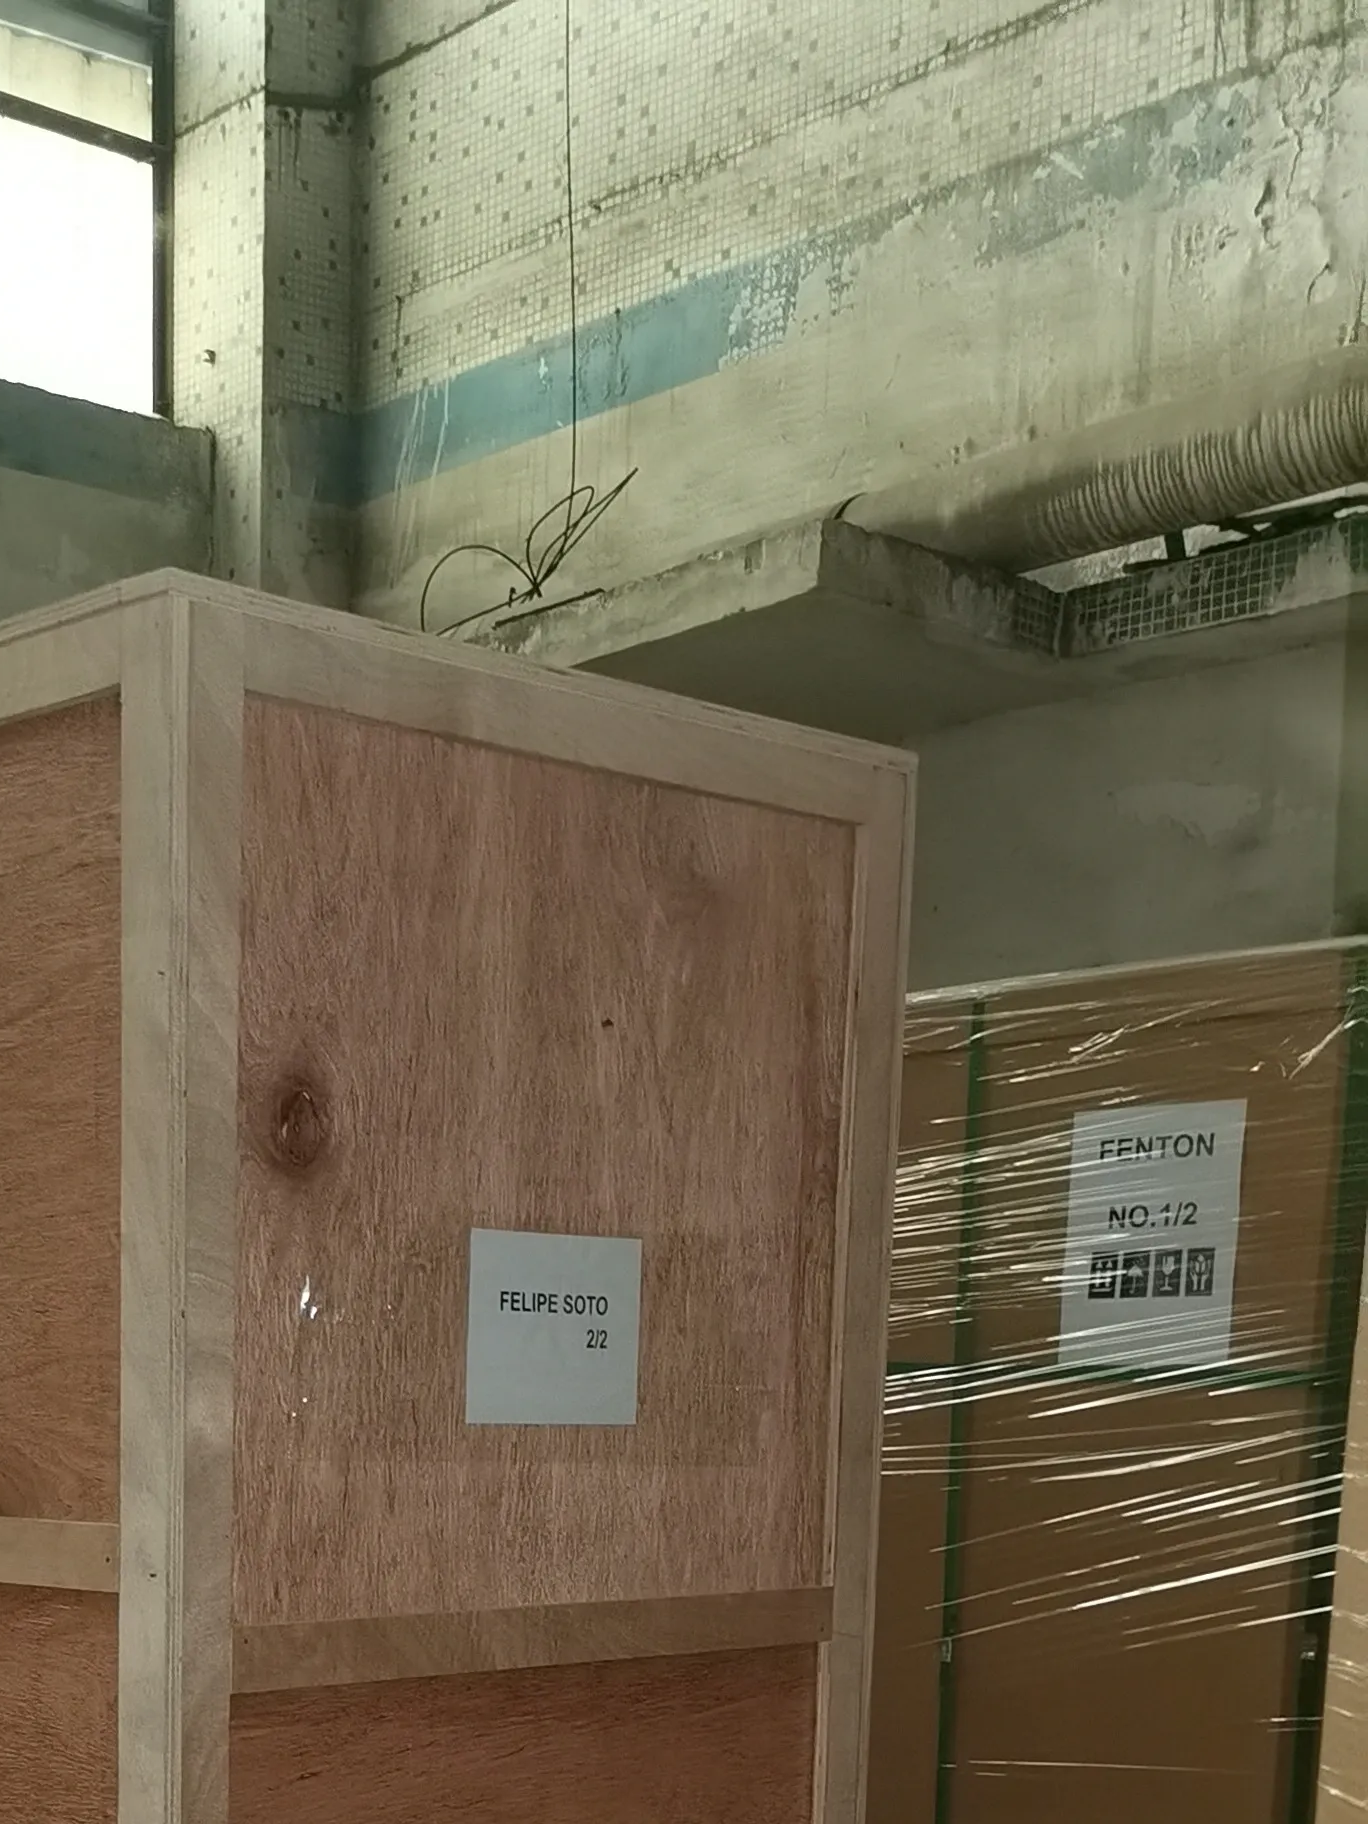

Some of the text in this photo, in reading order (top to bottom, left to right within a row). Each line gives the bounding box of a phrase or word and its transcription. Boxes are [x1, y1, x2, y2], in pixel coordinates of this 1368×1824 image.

[1099, 1132, 1216, 1161] FENTON
[1108, 1202, 1199, 1229] NO.1/2
[500, 1291, 608, 1316] FELIPE SOTO
[586, 1329, 608, 1349] 2/2
